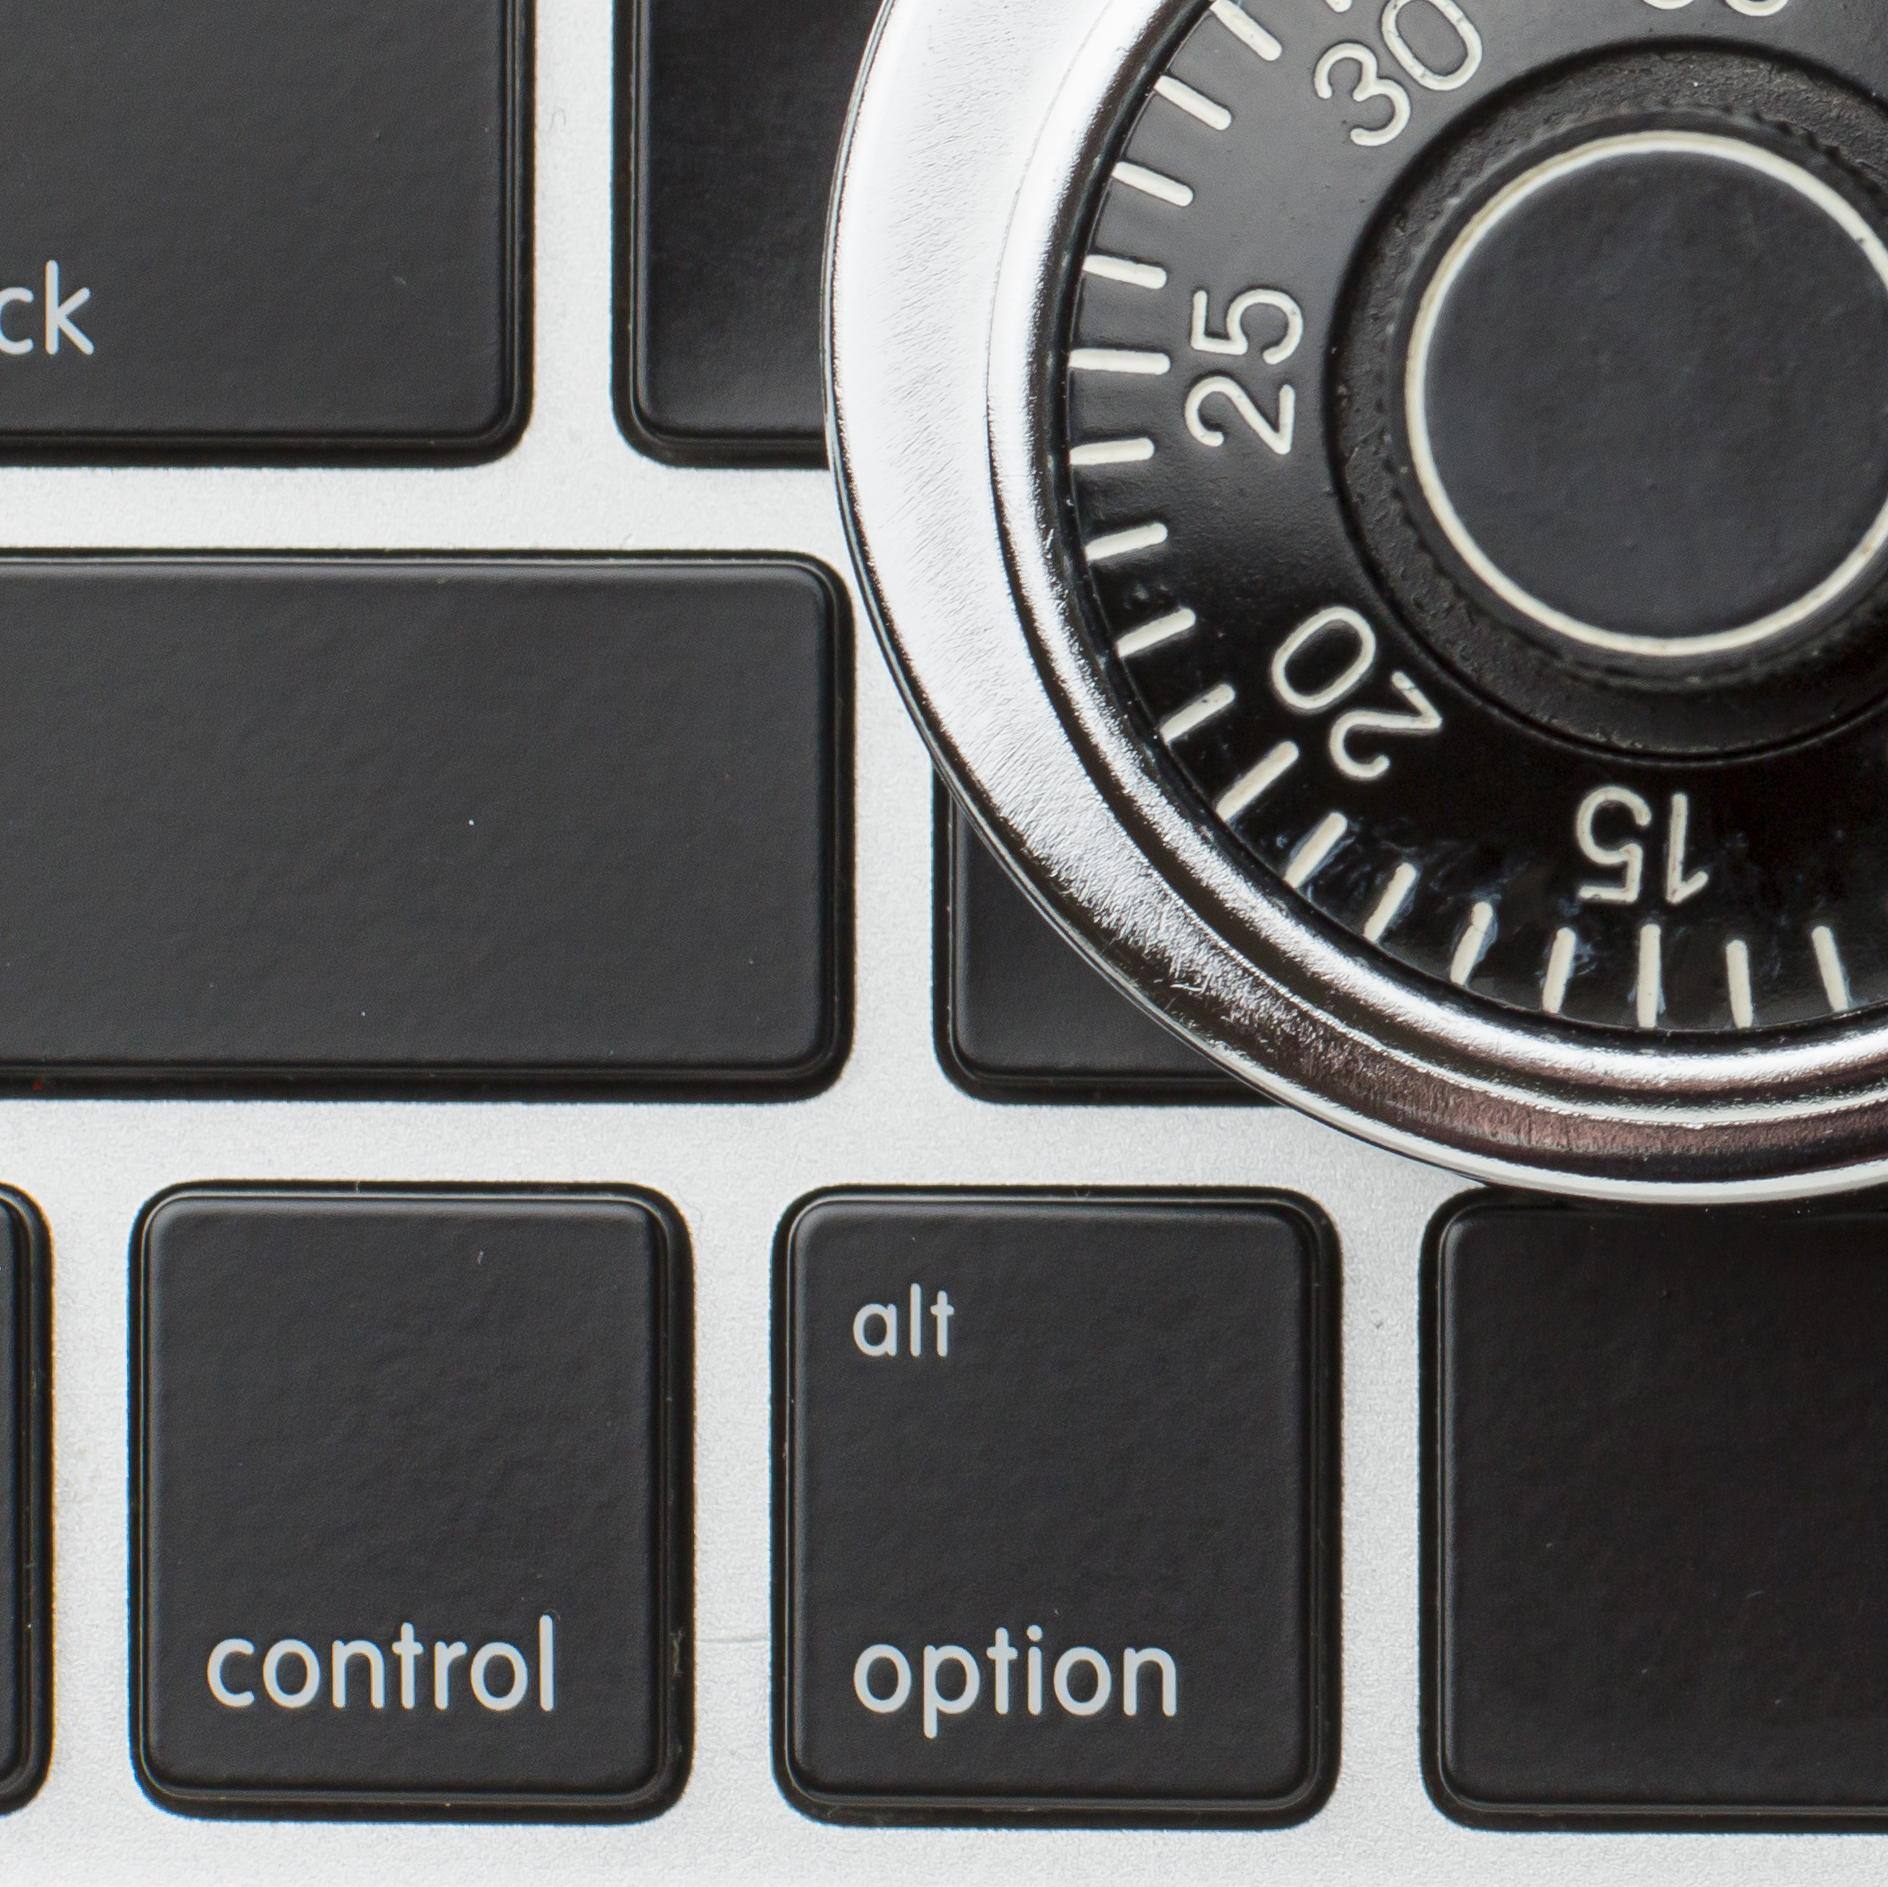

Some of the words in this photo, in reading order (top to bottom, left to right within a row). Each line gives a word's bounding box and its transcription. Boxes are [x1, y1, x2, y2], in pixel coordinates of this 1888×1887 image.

[1184, 288, 1304, 456] 25
[1272, 609, 1443, 778] 20
[1575, 785, 1709, 905] 15
[852, 1282, 955, 1358] alt
[206, 1614, 554, 1712] control
[853, 1624, 1177, 1740] option
